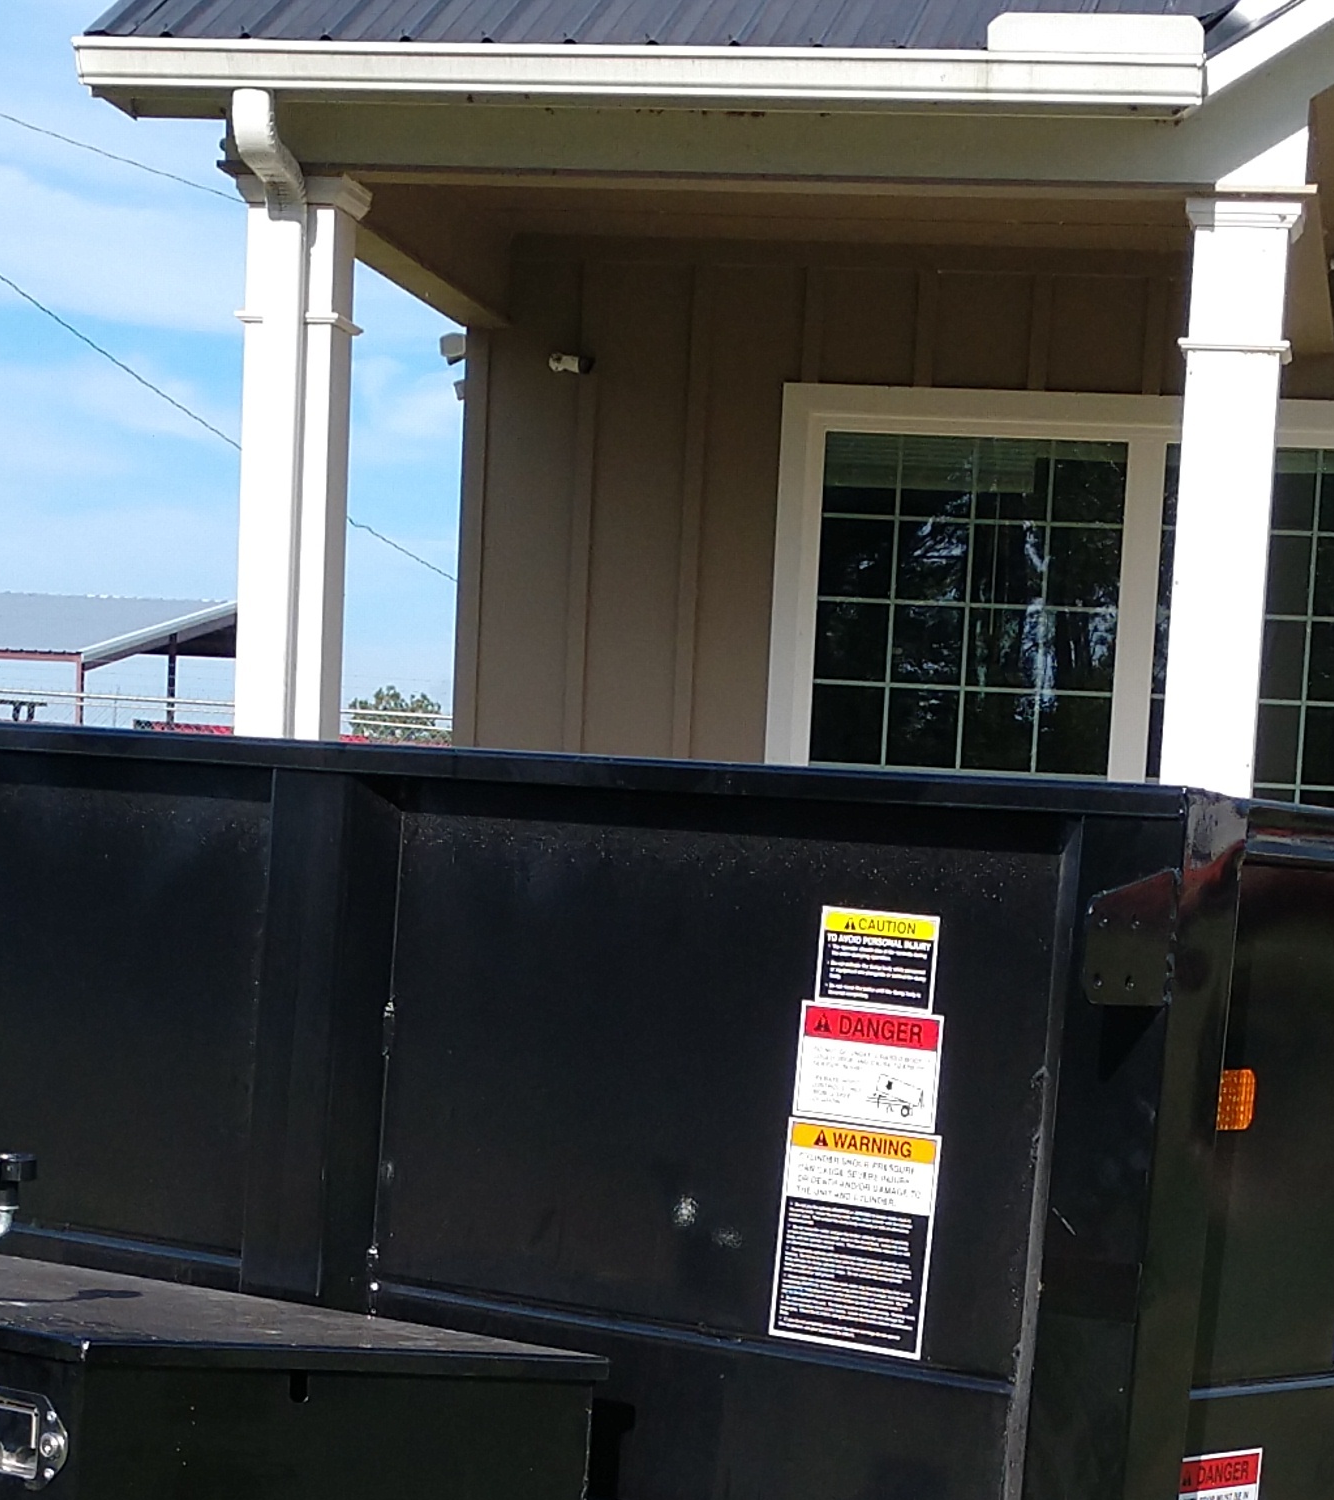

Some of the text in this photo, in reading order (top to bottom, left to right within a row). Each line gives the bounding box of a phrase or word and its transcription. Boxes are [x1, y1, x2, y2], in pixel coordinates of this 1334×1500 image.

[858, 917, 916, 935] CAUTION
[839, 1014, 923, 1045] DANGER
[833, 1131, 912, 1159] WARNING
[1197, 1460, 1249, 1485] DANGER
